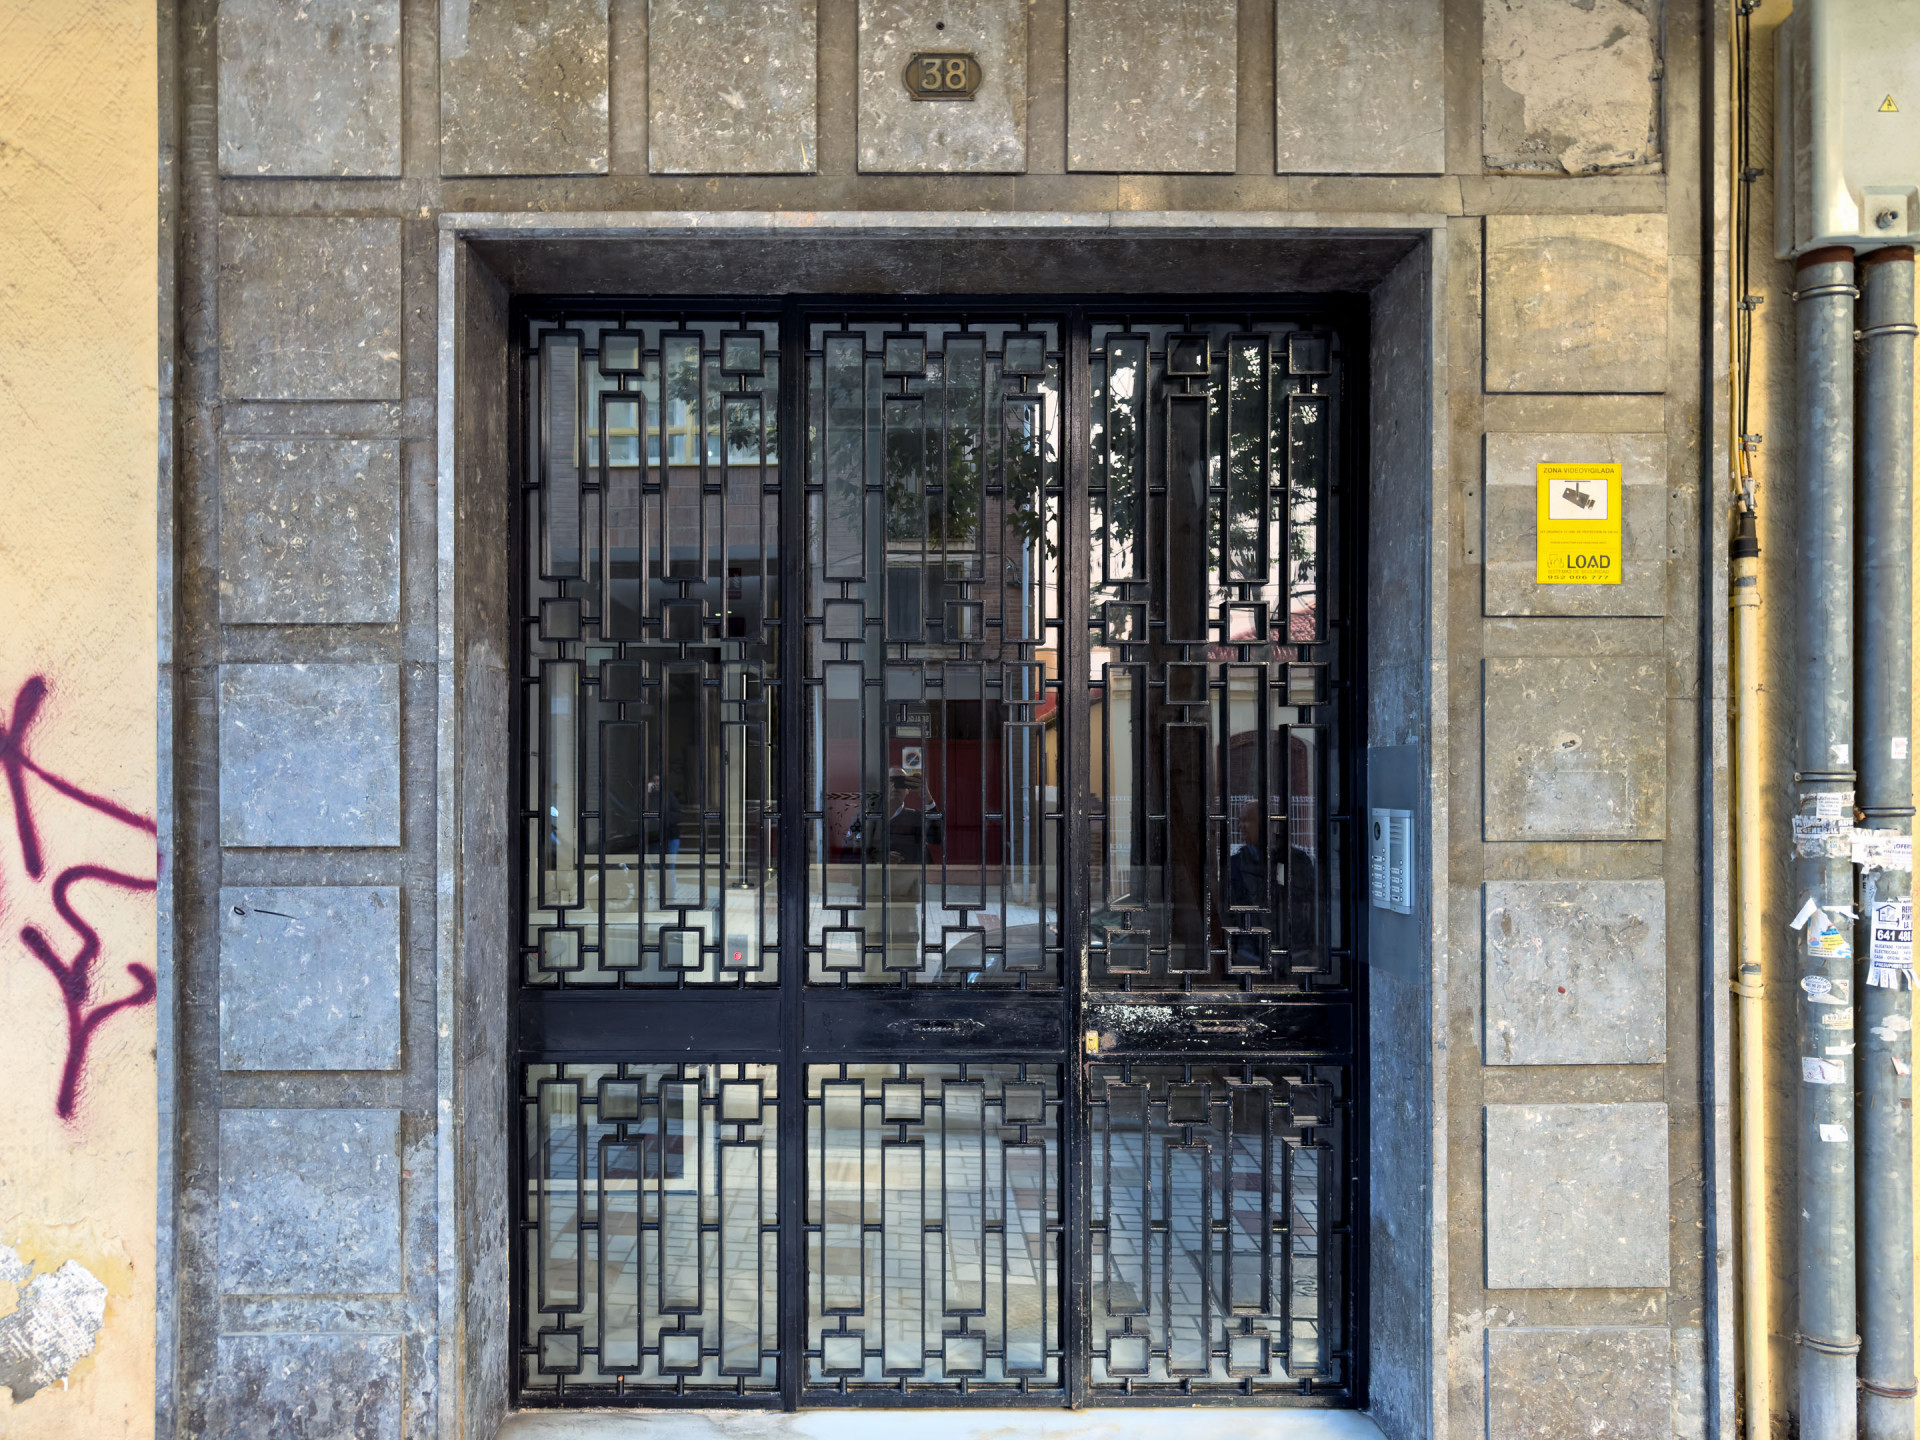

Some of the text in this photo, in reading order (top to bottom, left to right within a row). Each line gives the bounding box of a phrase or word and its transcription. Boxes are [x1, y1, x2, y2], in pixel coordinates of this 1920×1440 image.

[921, 58, 966, 90] 38
[1567, 554, 1611, 569] LOAD
[1877, 930, 1895, 941] 641
